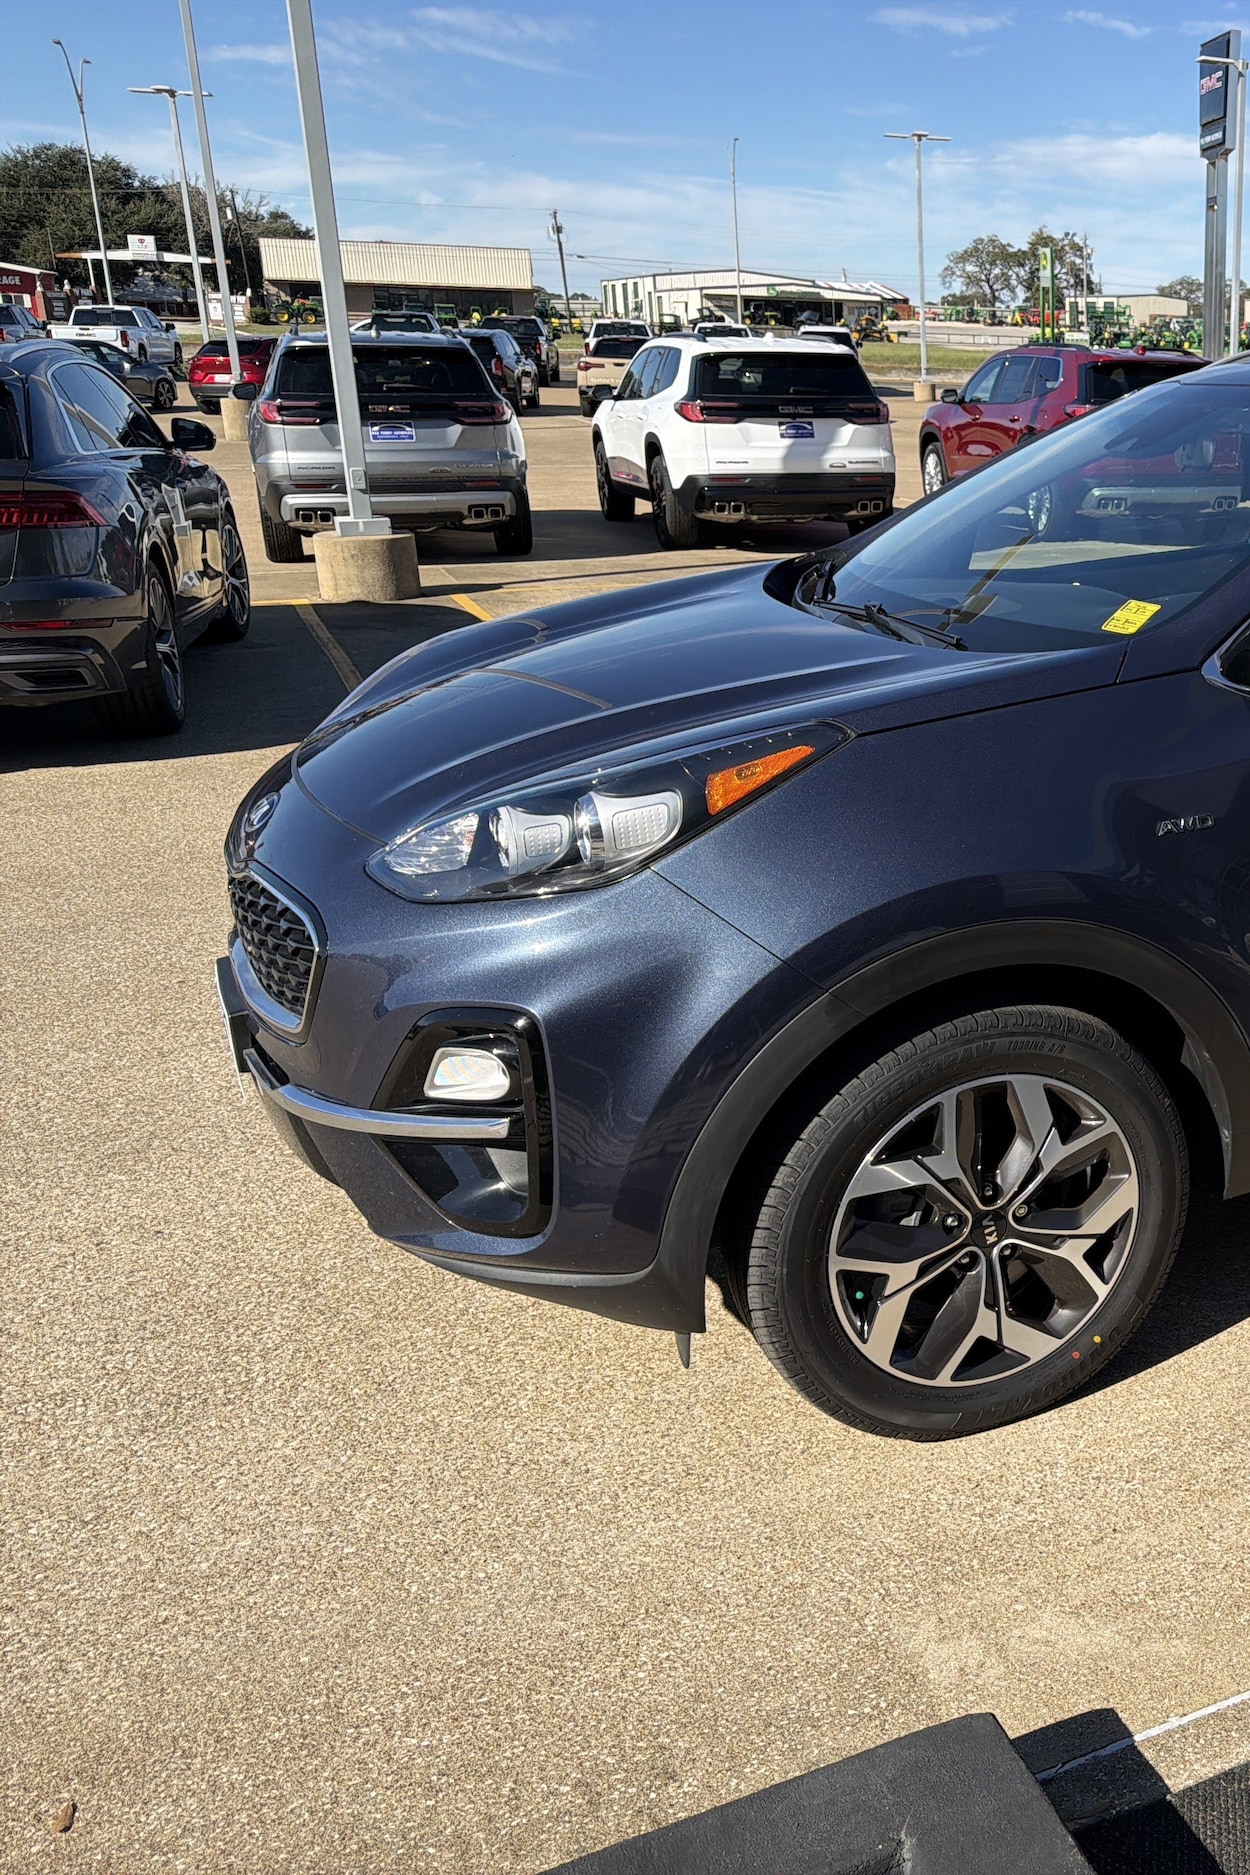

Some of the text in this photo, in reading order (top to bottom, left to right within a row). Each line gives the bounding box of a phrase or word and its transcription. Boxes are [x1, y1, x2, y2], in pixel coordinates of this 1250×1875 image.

[1200, 70, 1224, 95] GMC
[1156, 814, 1214, 837] AWD
[853, 1041, 1066, 1127] TIGER PAW TOURING A/S
[982, 1214, 999, 1245] KIA
